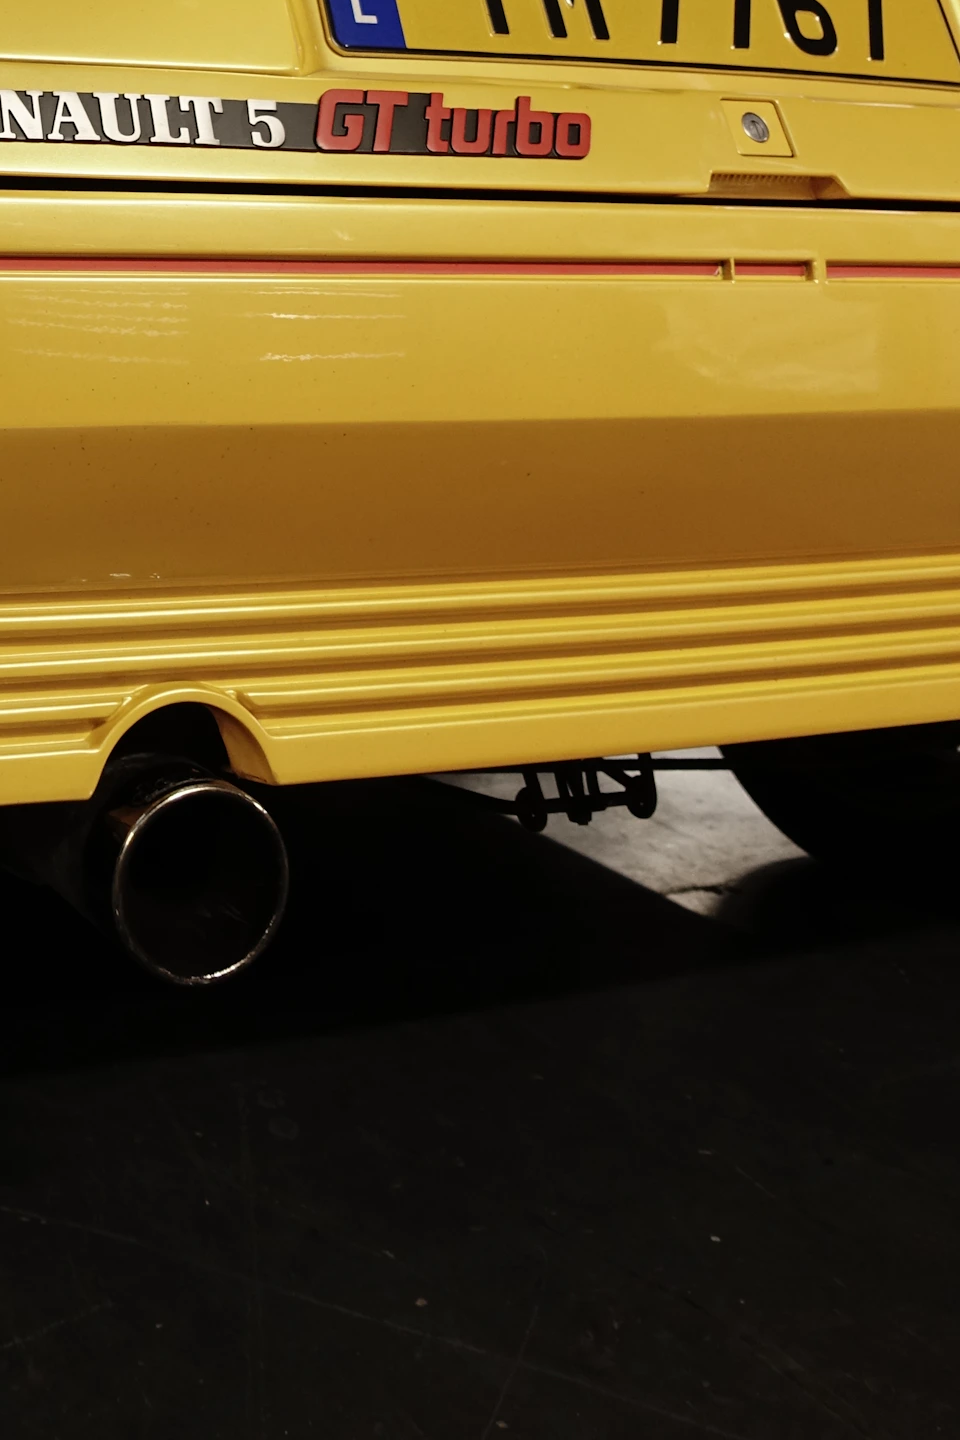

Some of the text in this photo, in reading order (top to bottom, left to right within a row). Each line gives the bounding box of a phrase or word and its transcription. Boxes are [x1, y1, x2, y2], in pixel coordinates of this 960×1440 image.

[246, 99, 287, 150] 5
[315, 88, 410, 153] GT
[424, 91, 592, 160] turbo
